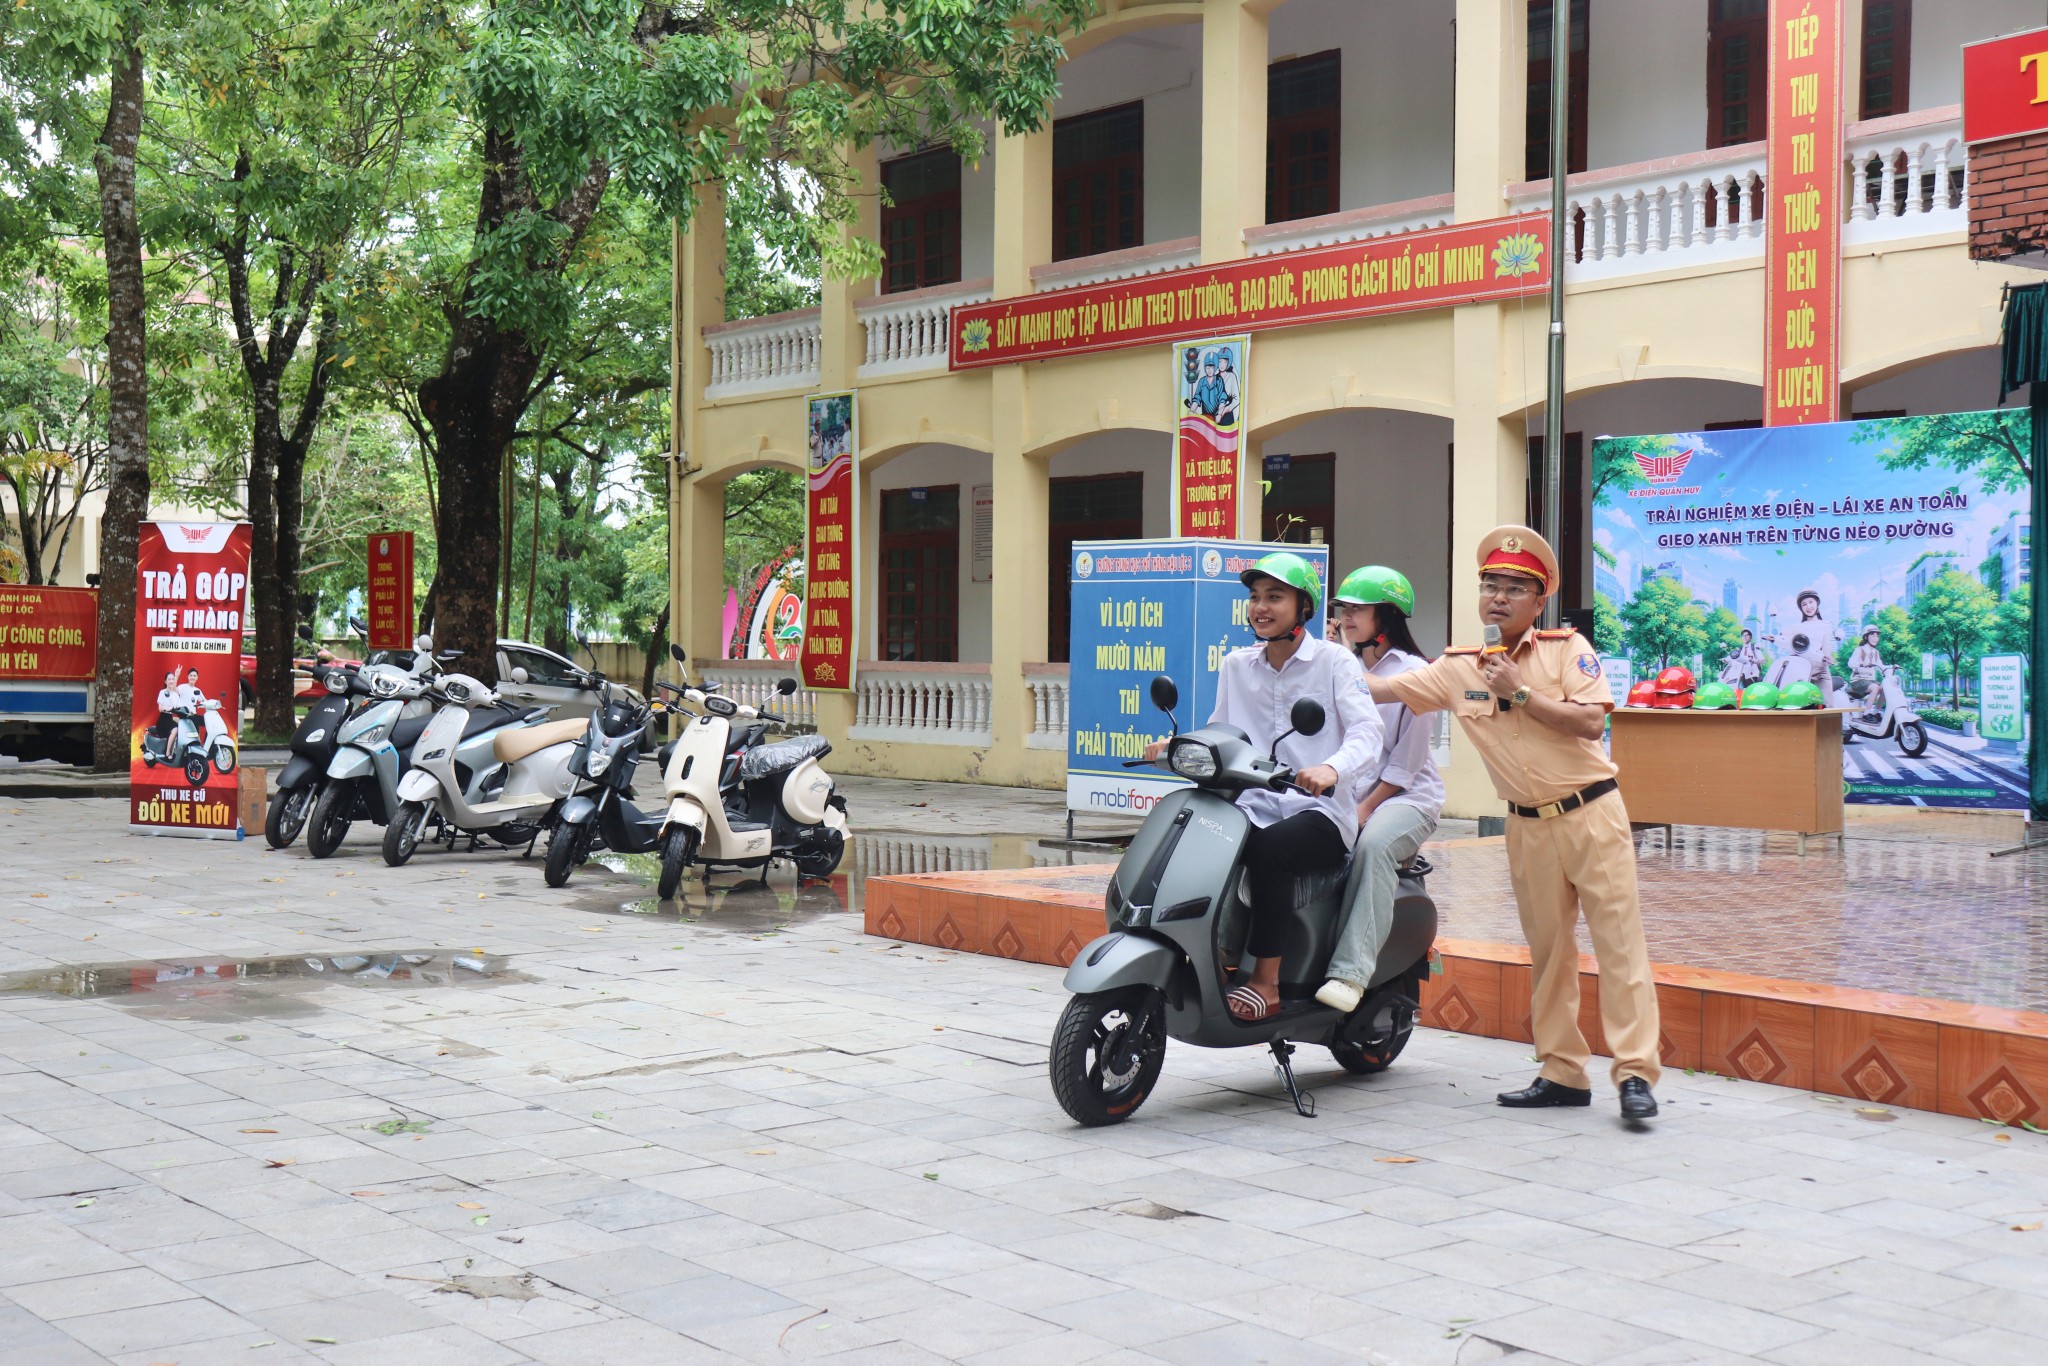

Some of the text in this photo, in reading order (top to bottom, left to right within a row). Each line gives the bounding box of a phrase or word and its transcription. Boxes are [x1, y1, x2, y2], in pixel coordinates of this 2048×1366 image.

[1786, 2, 1819, 60] TIẾP
[2020, 51, 2048, 105] T
[1790, 73, 1819, 124] THỤ
[1792, 132, 1815, 176] TRI
[1784, 182, 1821, 234] THỨC
[1786, 242, 1817, 292] RÈN
[997, 243, 1484, 350] ĐẨY MẠNH HỌC TẬP VÀ LÀM THEO TƯ TƯỞNG, ĐẠO ĐỨC, PHONG CÁCH HỒ CHÍ MINH
[1786, 299, 1815, 350] ĐỨC
[1777, 357, 1823, 416] LUYỆN
[1186, 459, 1196, 478] XÃ
[1186, 482, 1216, 503] TRƯỜNG
[1628, 486, 1701, 498] XE ĐIỆN QUÂN HUY
[1646, 505, 1680, 523] TRẢI
[1685, 502, 1747, 523] NGHIỆM
[1751, 505, 1771, 518] XE
[1775, 499, 1814, 520] ĐIỆN
[1832, 496, 1859, 515] LÁI
[1863, 499, 1884, 513] XE
[1889, 497, 1913, 512] AN
[1918, 491, 1967, 510] TOÀN
[1192, 508, 1206, 531] HẬU
[1209, 507, 1220, 530] LỘ
[1657, 519, 1953, 547] GIEO XANH TRÊN TỪNG NẺO ĐƯỜNG
[143, 563, 245, 601] TRẢ GÓP
[0, 594, 19, 603] ANH
[0, 604, 34, 615] ỆU LỘC
[1100, 596, 1163, 633] VÌ LỢI ÍCH
[147, 606, 239, 633] NHẸ NHÀNG
[1232, 598, 1250, 632] HỌ
[0, 624, 85, 648] Ự CÔNG CỘNG,
[157, 638, 179, 650] KHÔNG
[809, 633, 824, 654] THÂN
[14, 649, 38, 669] YÊN
[1096, 639, 1166, 672] MƯỜI NĂM
[1119, 684, 1140, 715] THÌ
[1076, 723, 1106, 756] PHẢI
[138, 794, 230, 826] ĐỔI XE MỚI
[160, 788, 206, 802] THU XE CŨ
